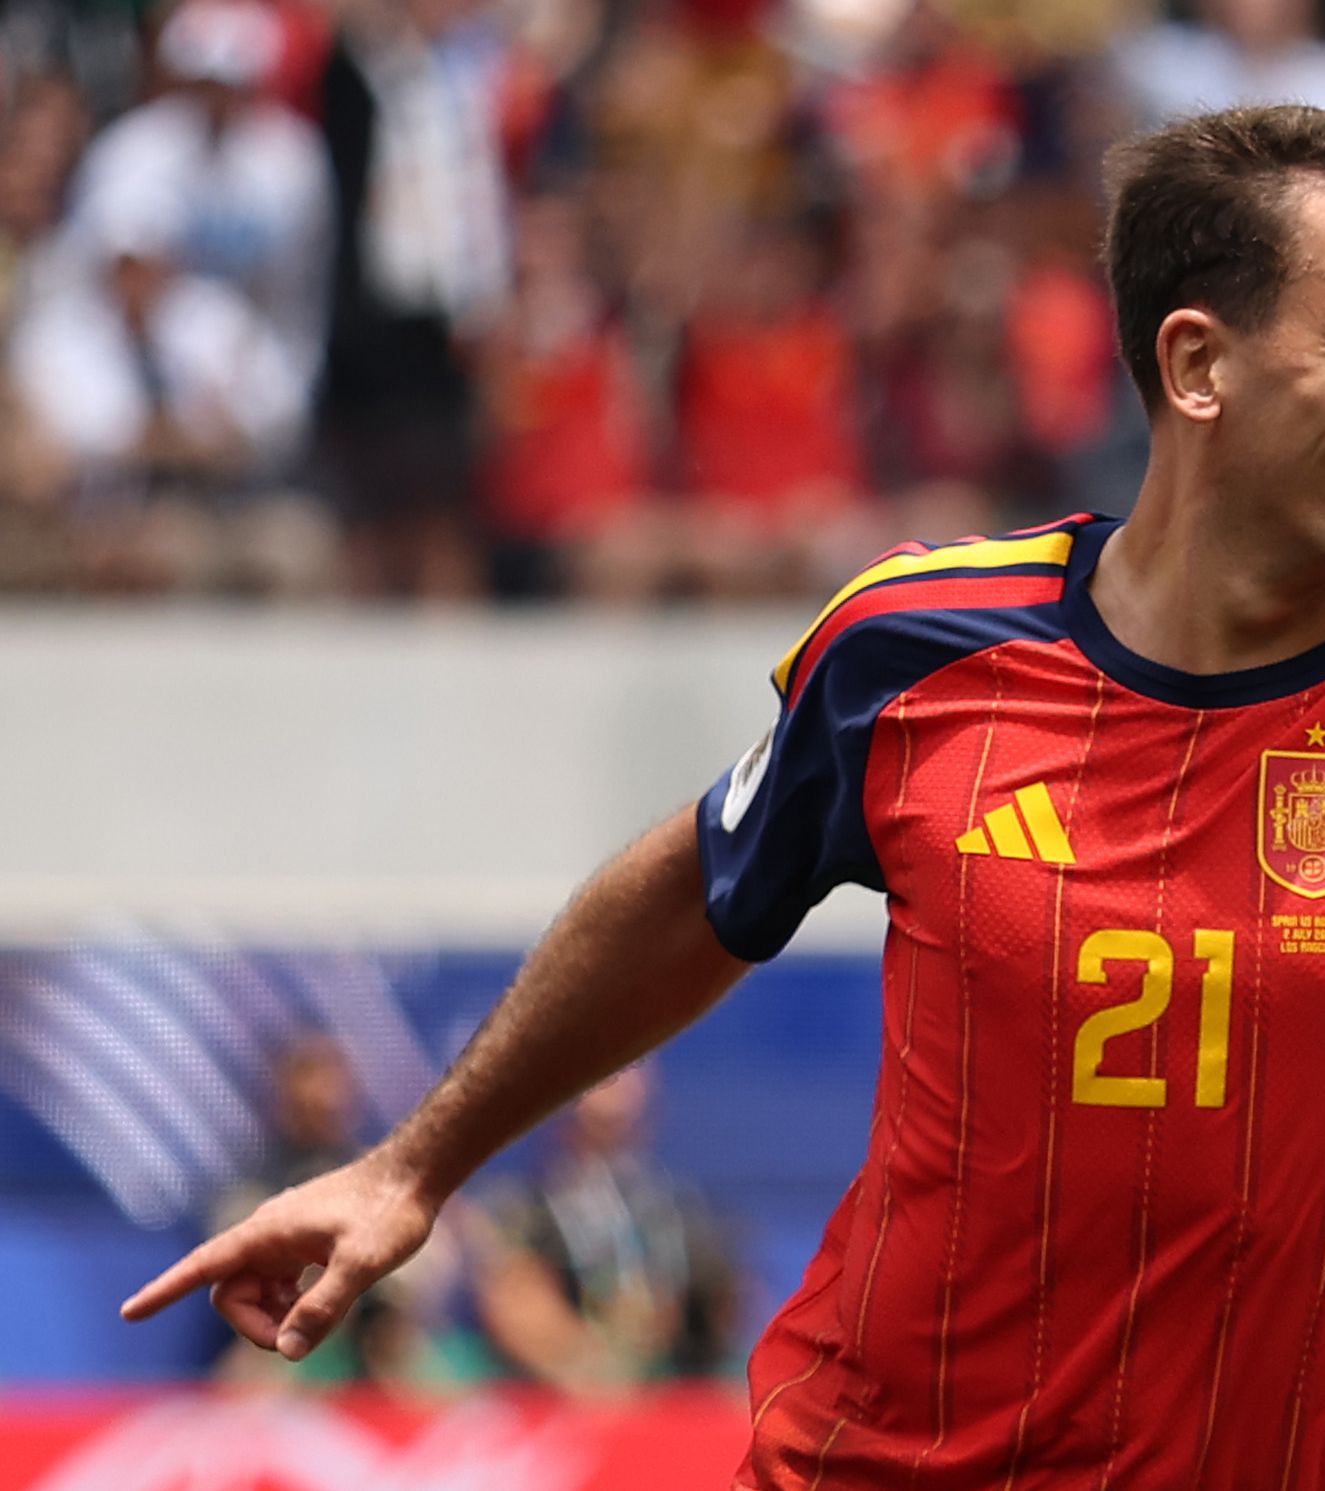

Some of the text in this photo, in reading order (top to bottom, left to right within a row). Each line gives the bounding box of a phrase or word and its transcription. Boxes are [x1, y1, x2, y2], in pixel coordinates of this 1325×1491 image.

[1292, 928, 1312, 940] JULY
[1280, 941, 1298, 953] LOS
[1072, 928, 1235, 1108] 21
